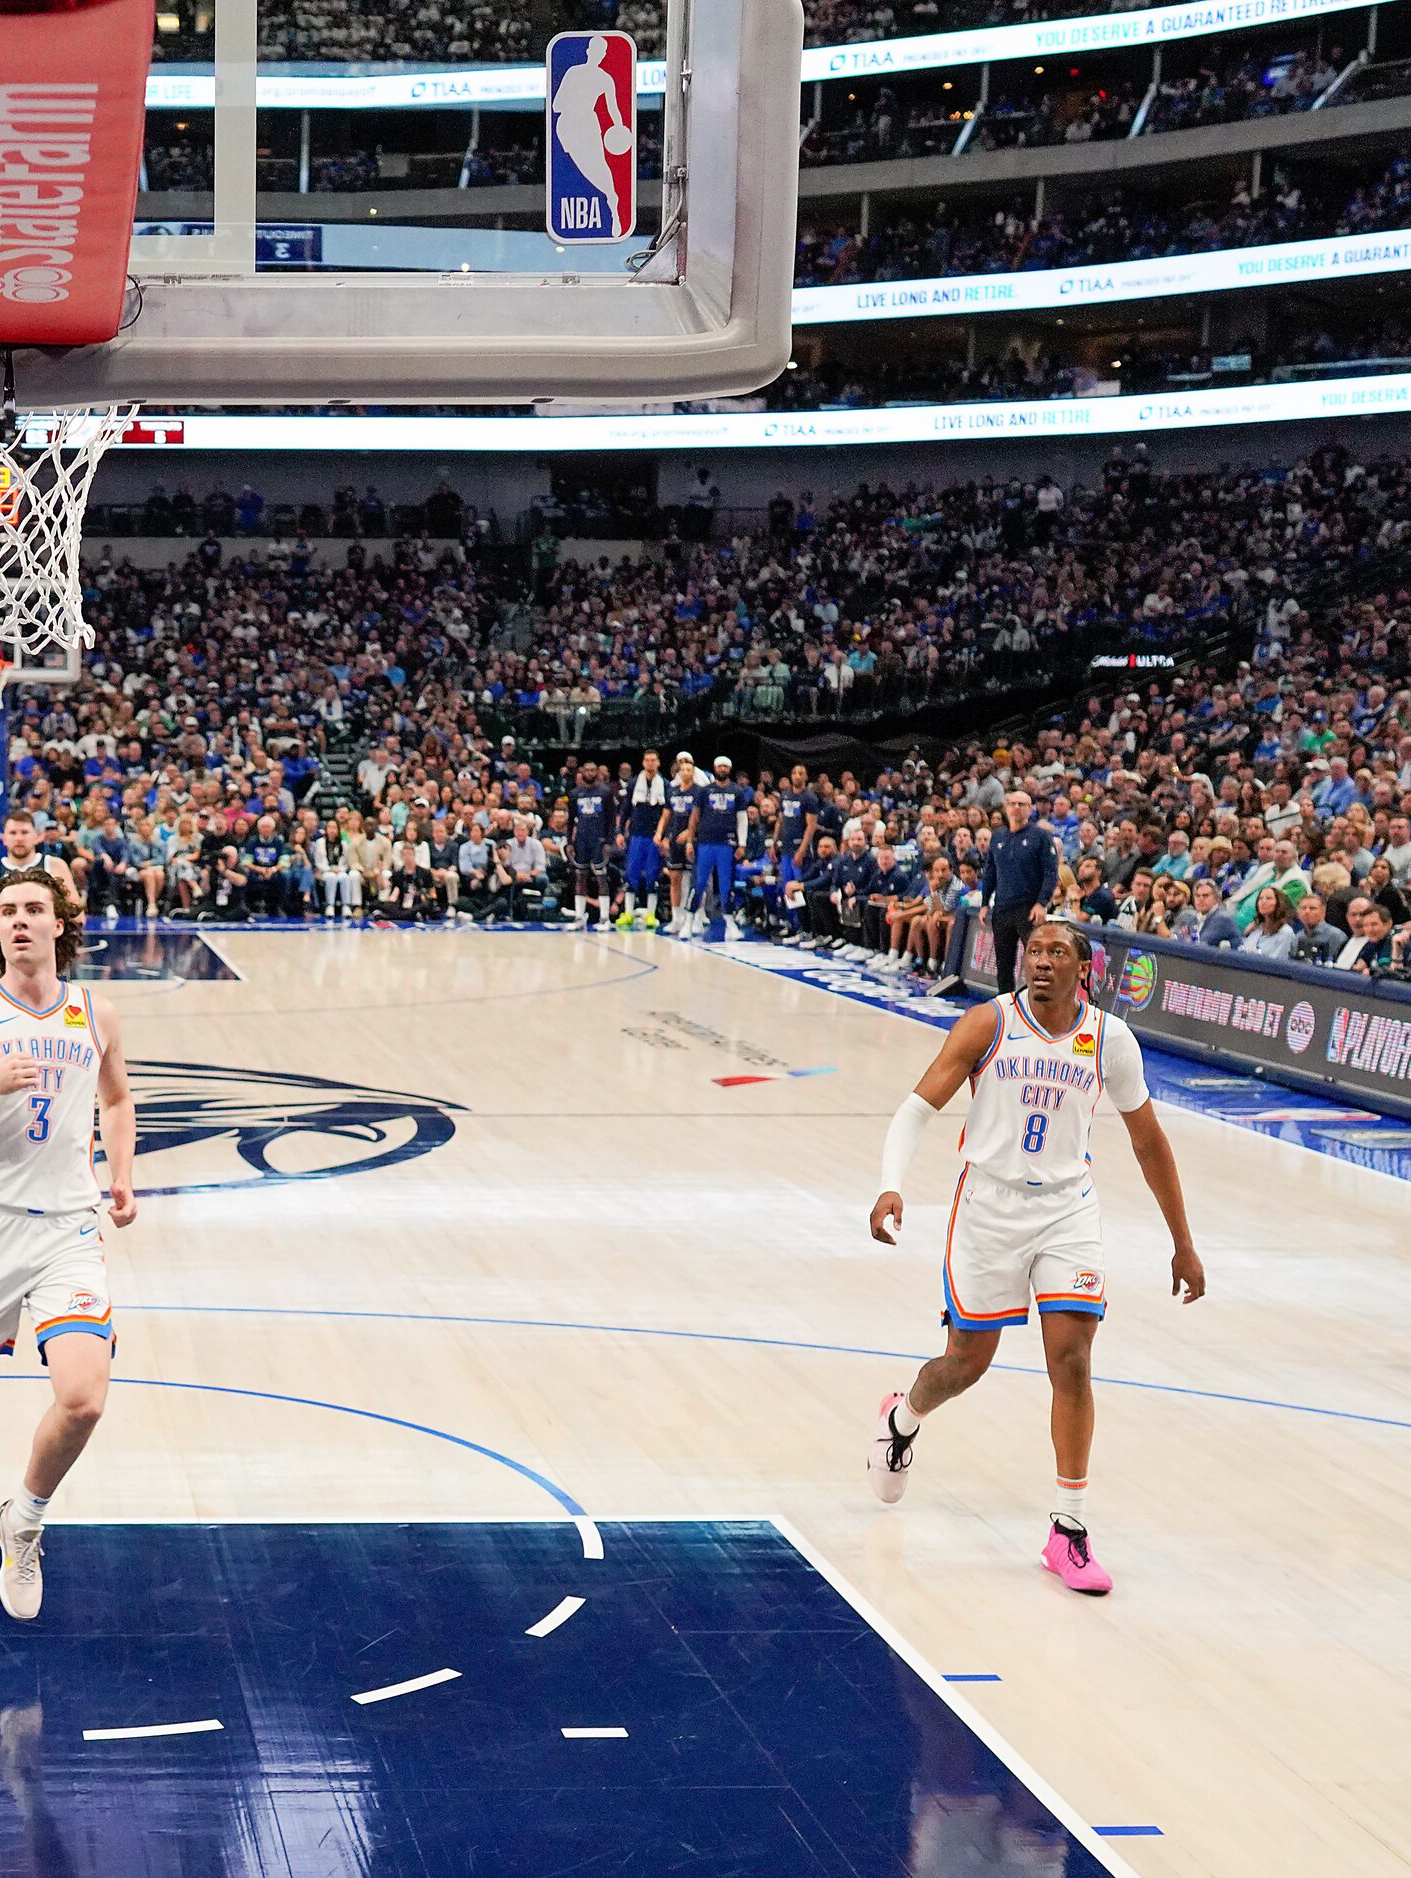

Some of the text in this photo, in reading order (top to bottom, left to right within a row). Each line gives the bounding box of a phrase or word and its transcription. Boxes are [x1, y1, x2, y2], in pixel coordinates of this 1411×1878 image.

[1035, 29, 1065, 49] YOU
[1070, 21, 1141, 45] DESERVE
[1146, 19, 1155, 36] A
[1161, 1, 1265, 35] GUARANTEED
[853, 50, 895, 70] TIAA
[430, 81, 472, 97] TIAA
[560, 196, 603, 230] NBA
[1237, 258, 1264, 276] YOU
[1267, 252, 1327, 274] DESERVE
[1331, 250, 1340, 267] A
[1078, 277, 1115, 293] TIAA
[856, 293, 887, 310] LIVE
[891, 291, 929, 308] LONG
[932, 288, 961, 305] AND
[1321, 385, 1410, 407] YOU DESERVE
[933, 414, 963, 431] LIVE
[968, 412, 1004, 430] LONG
[1007, 410, 1038, 427] AND
[1151, 401, 1194, 419] TIAA
[780, 423, 817, 439] TIAA
[1136, 654, 1174, 668] ULTRA
[1289, 1016, 1313, 1036] abc
[994, 1056, 1096, 1097] OKLAHOMA
[1019, 1082, 1066, 1112] CITY
[24, 1095, 53, 1146] 3
[1021, 1111, 1050, 1157] 8
